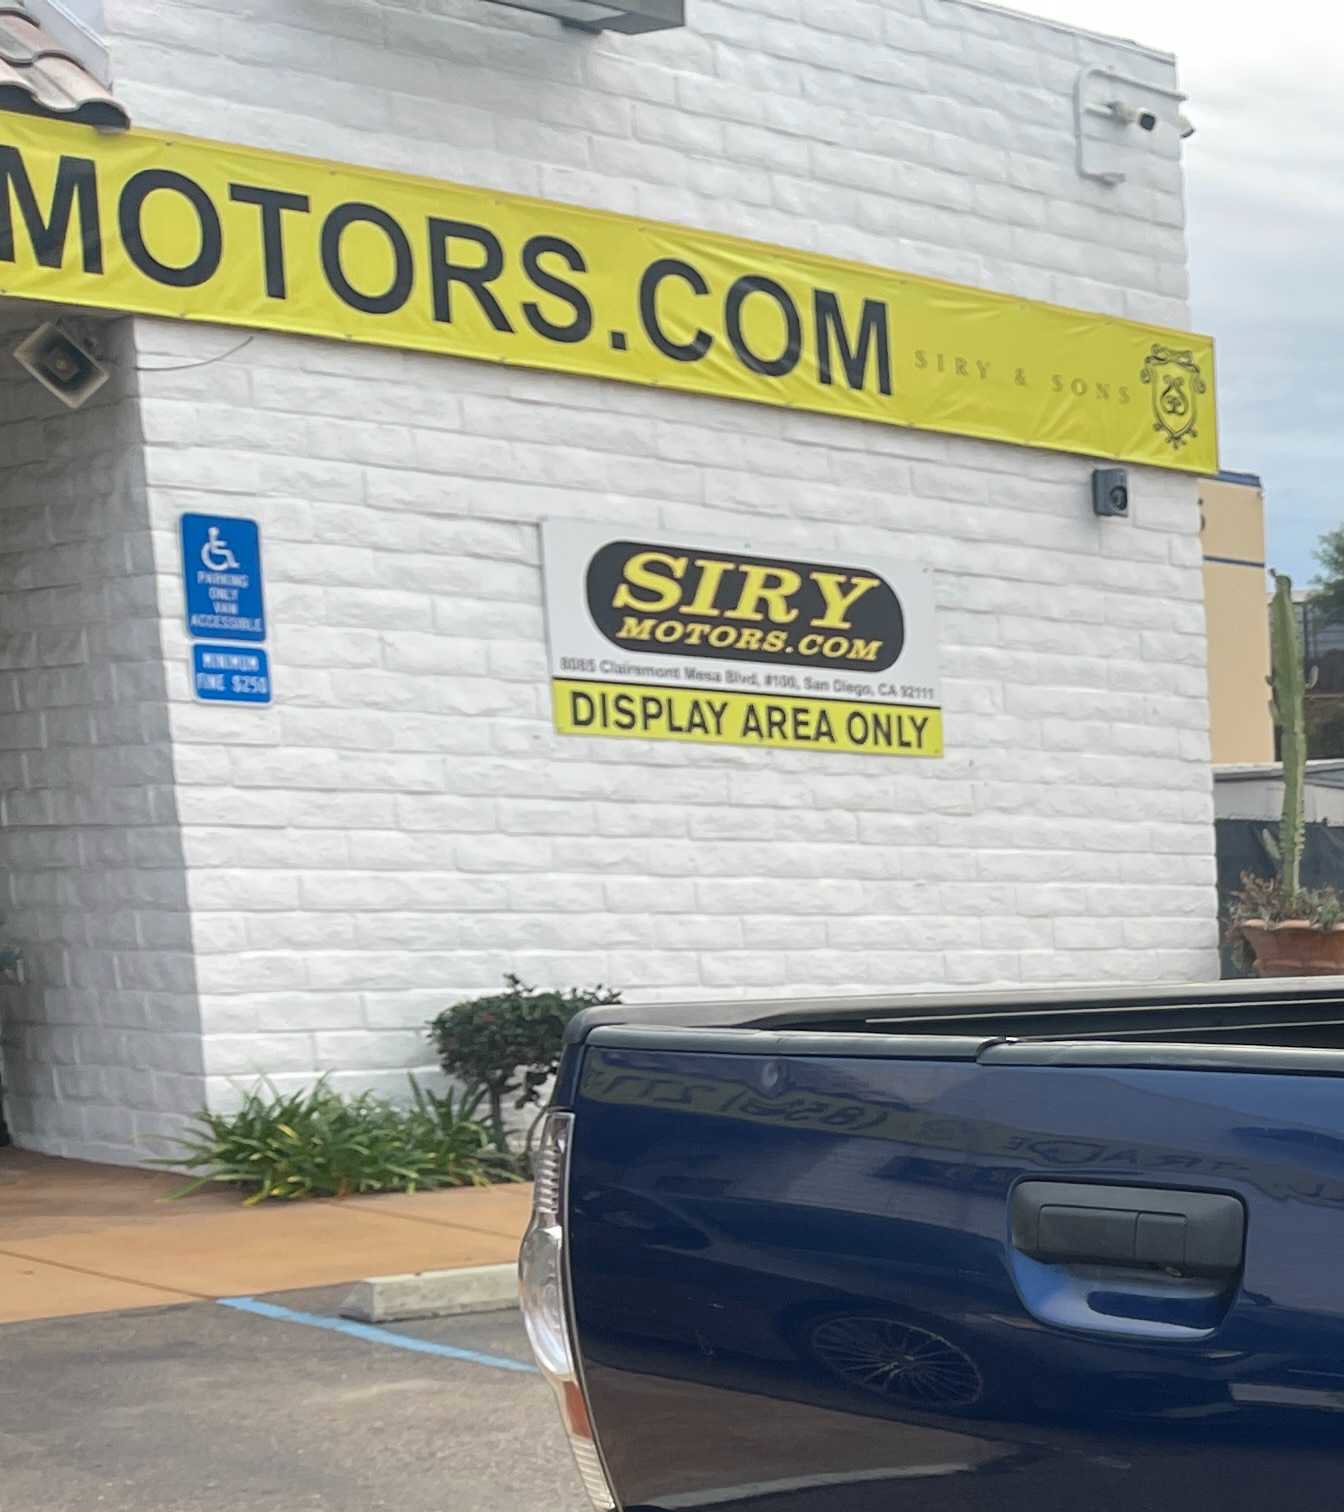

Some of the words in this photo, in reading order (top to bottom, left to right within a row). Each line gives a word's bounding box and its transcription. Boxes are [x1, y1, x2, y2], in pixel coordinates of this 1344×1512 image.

[0, 144, 892, 396] MOTORS.COM
[914, 350, 990, 379] SIRY
[1013, 367, 1027, 386] &
[1051, 374, 1130, 404] SONS
[197, 571, 248, 588] PARKING
[208, 587, 238, 600] ONLY
[612, 551, 881, 630] SIRY
[213, 601, 238, 614] VAN
[616, 617, 883, 661] MOTORS.COM
[202, 653, 260, 672] MINIMUM
[600, 659, 681, 679] Clairemont
[685, 667, 722, 682] Mesa
[803, 677, 830, 691] San
[878, 684, 897, 696] CA
[197, 673, 226, 691] FINE
[232, 675, 267, 694] $250
[570, 690, 728, 736] DISPLAY
[742, 704, 836, 744] AREA
[846, 711, 929, 750] ONLY
